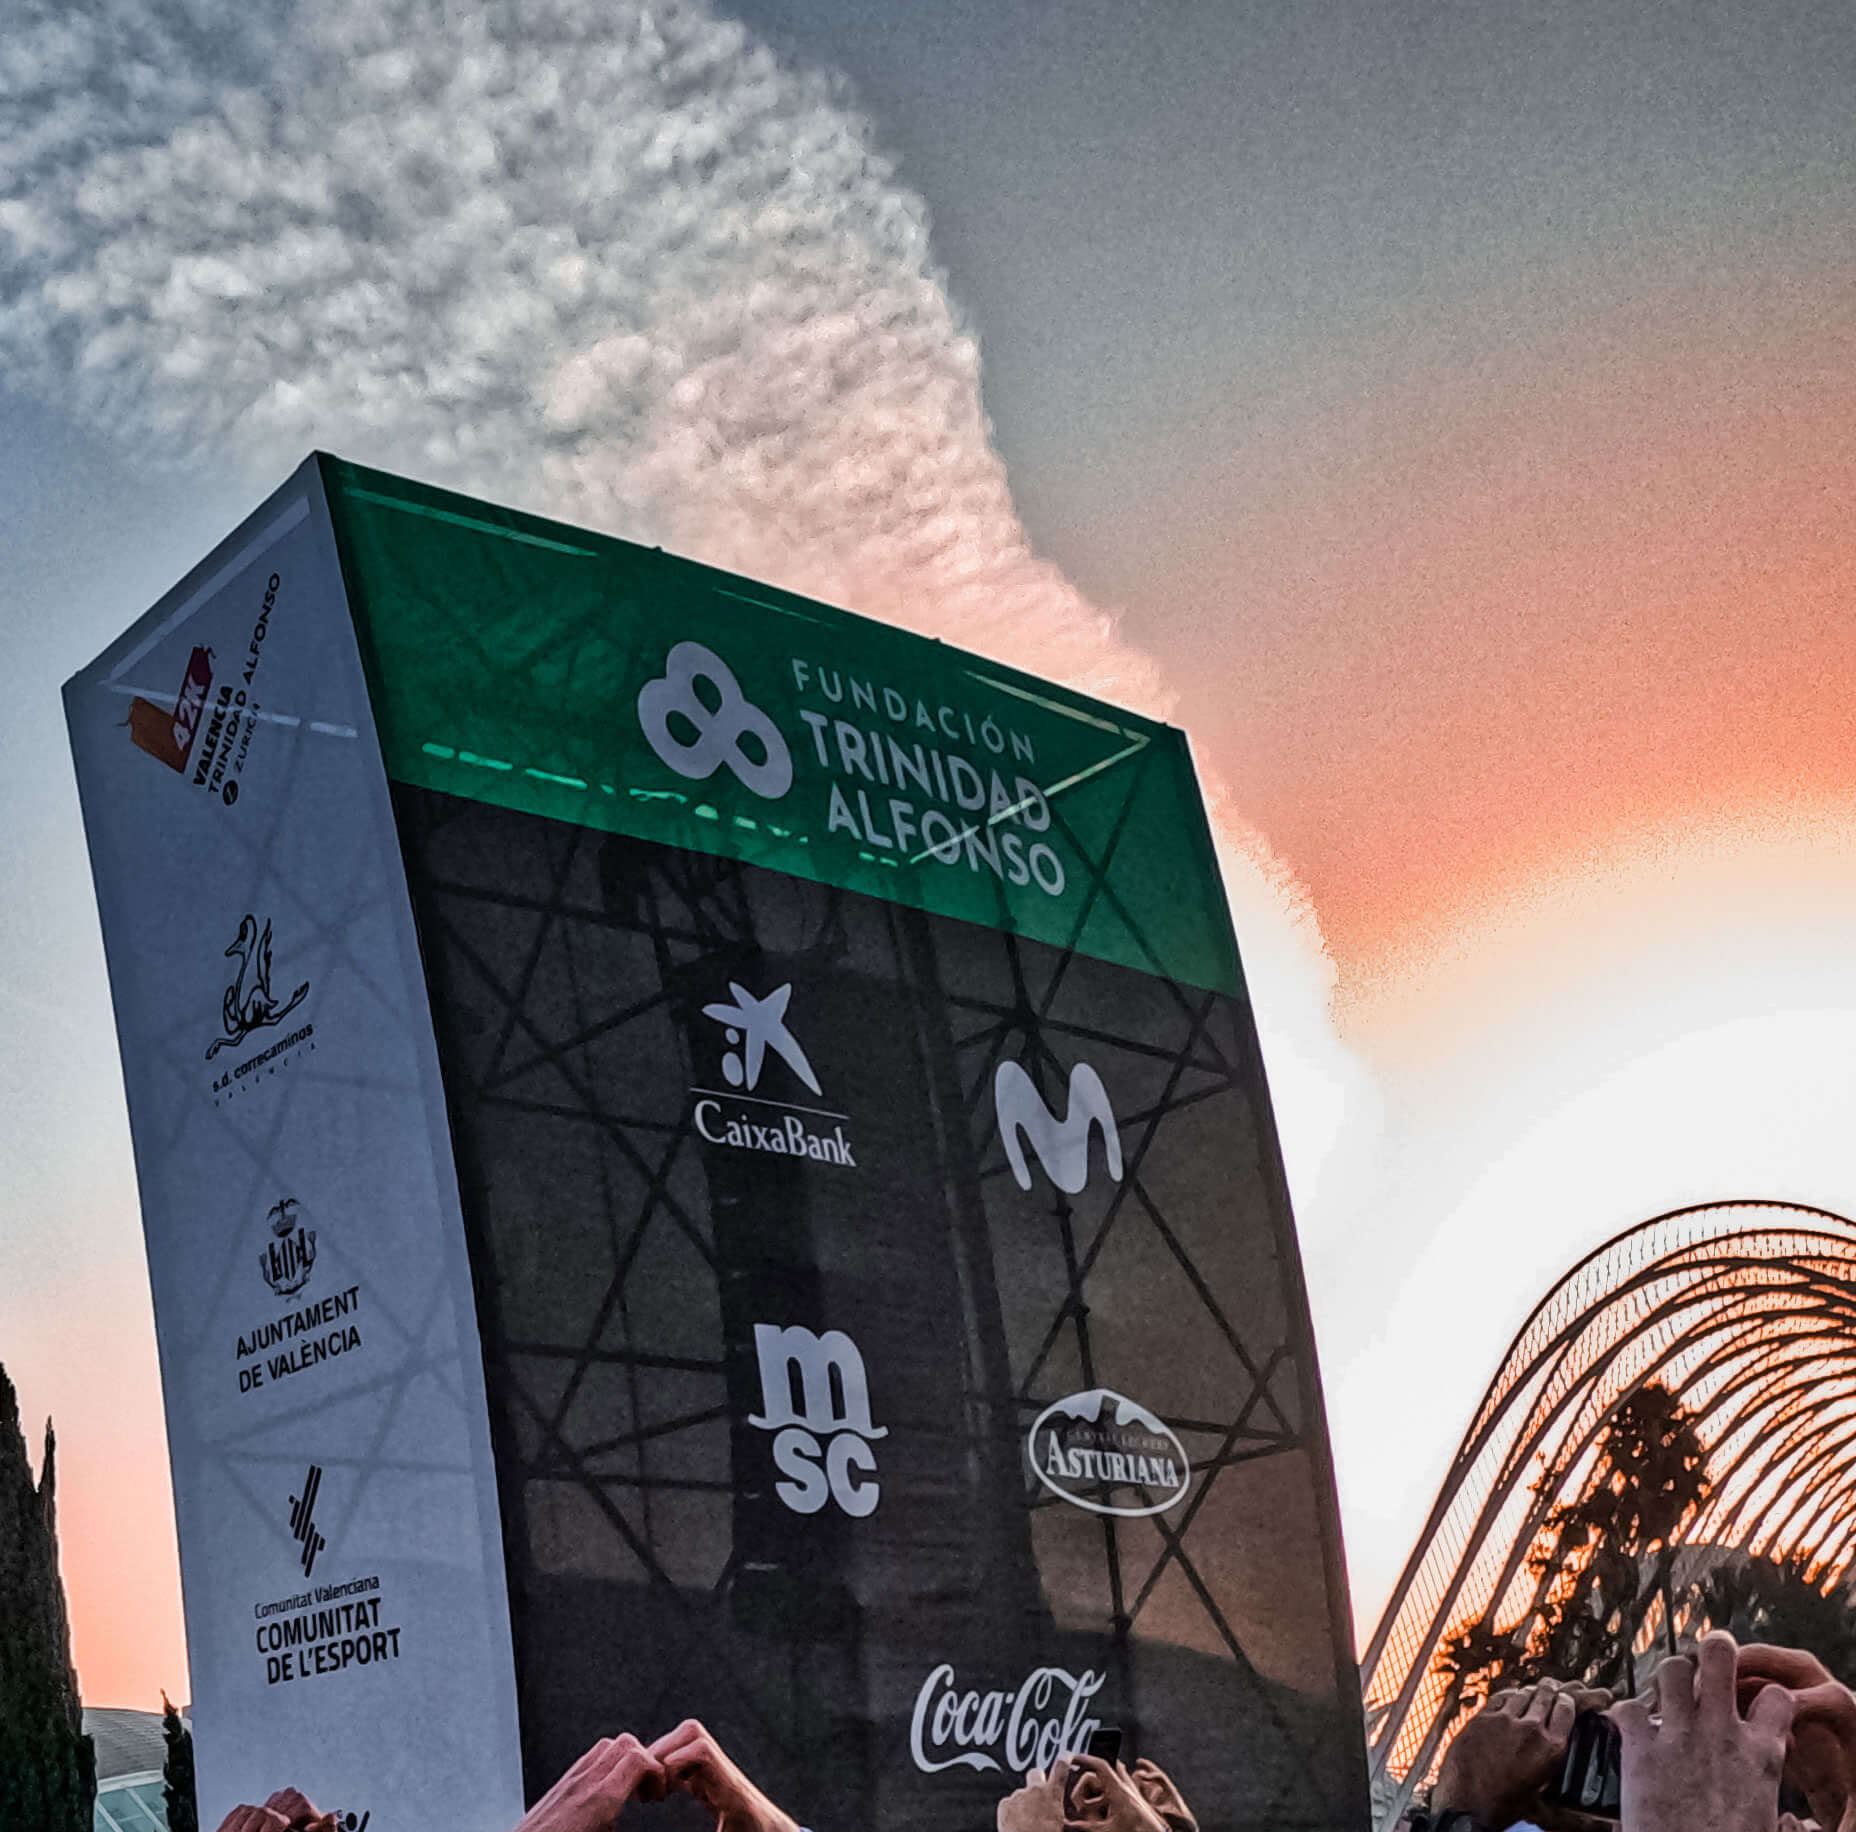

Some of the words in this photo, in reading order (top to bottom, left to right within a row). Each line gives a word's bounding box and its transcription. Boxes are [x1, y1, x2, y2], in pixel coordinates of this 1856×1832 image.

[208, 690, 247, 793] TRINIDAD
[243, 572, 281, 685] ALFONSO
[792, 658, 1036, 764] FUNDACIÓN
[193, 685, 234, 785] VALENCIA
[800, 710, 1052, 833] TRINIDAD
[828, 783, 1066, 897] ALFONSO
[233, 1023, 314, 1079] correcaminos
[693, 1101, 857, 1168] CaixaBank
[236, 1285, 361, 1361] AJUNTAMENT
[239, 1364, 264, 1394] DE
[267, 1324, 362, 1381] VALÈNCIA
[1046, 1429, 1180, 1488] ASTURIANA
[254, 1591, 313, 1620] Comunitat
[314, 1575, 380, 1604] Valenciana
[256, 1597, 382, 1654] COMUNITAT
[266, 1652, 295, 1685] DE
[299, 1627, 401, 1678] L'ESPORT
